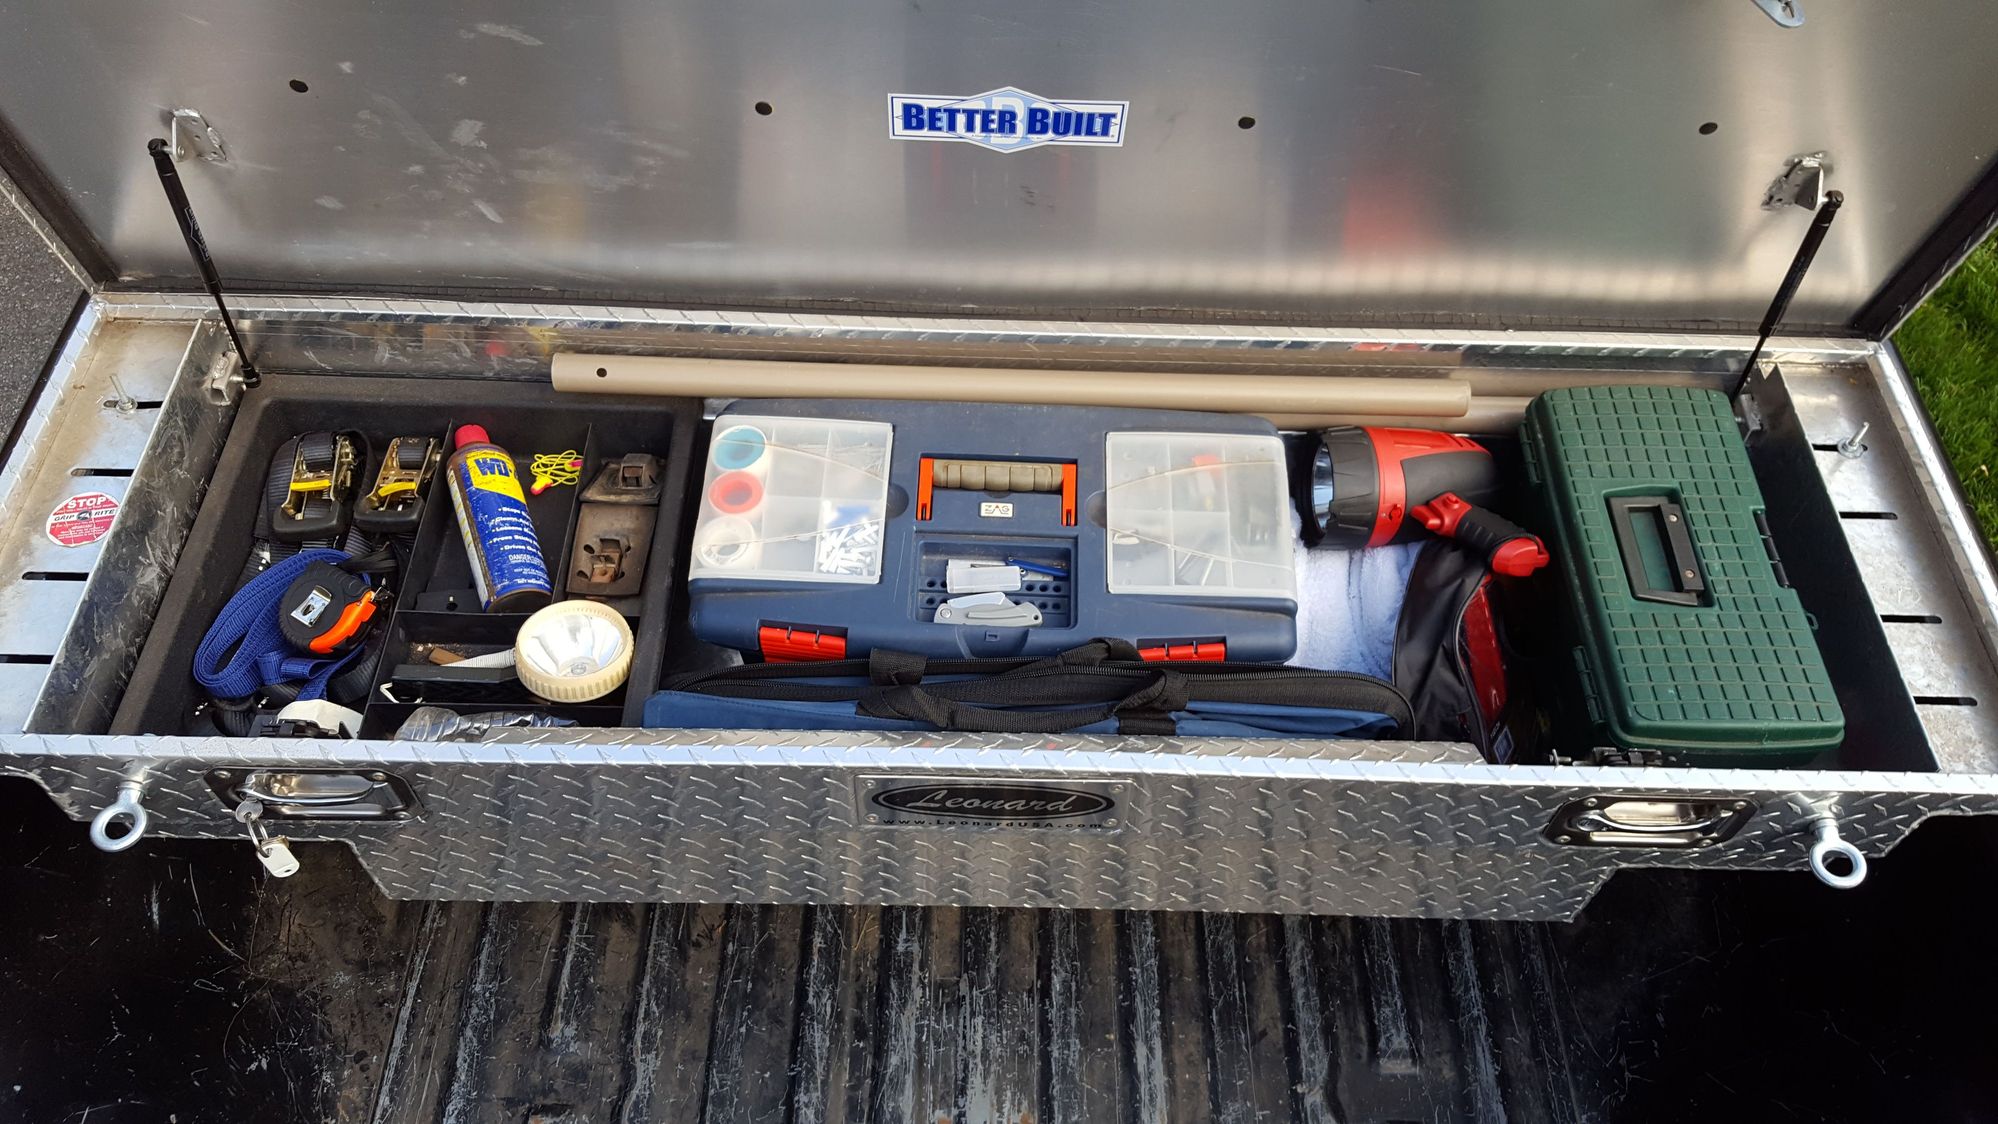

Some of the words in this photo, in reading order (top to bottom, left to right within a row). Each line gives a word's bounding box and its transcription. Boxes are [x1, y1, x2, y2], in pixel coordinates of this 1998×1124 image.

[902, 102, 1017, 135] BETTER
[1027, 107, 1119, 138] BUILT
[67, 496, 107, 509] STOP
[54, 514, 75, 522] GRIP
[94, 508, 115, 517] RITE
[905, 789, 1078, 812] Leonard
[883, 818, 1104, 829] www.LeonardUSA.com
